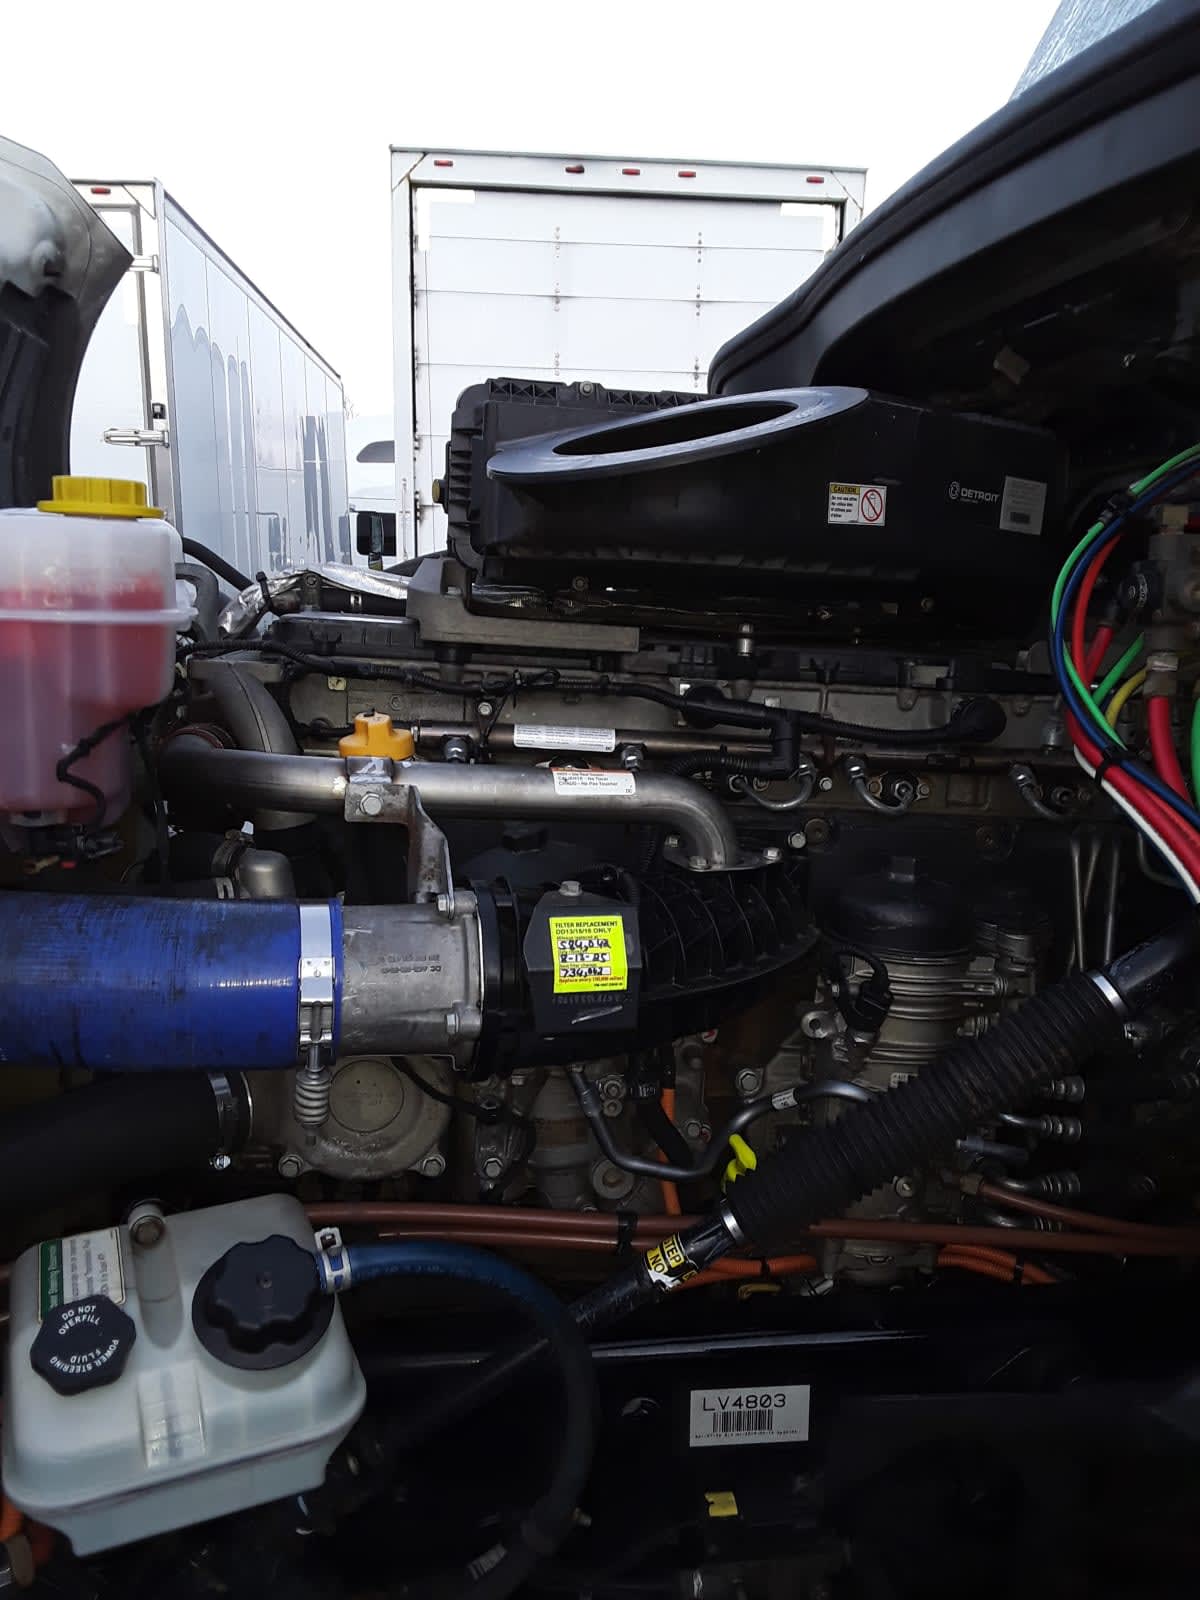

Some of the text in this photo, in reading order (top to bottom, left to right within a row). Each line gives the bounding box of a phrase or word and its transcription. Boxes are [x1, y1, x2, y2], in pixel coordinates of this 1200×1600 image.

[833, 485, 856, 493] CAUTION
[961, 488, 1000, 502] DETROIT
[650, 1254, 665, 1273] NO
[62, 1305, 96, 1320] DO NOT
[58, 1314, 101, 1335] OVERFILL
[50, 1339, 119, 1373] POWER STEERING
[70, 1349, 102, 1364] FLUID
[703, 1393, 786, 1411] LV4803
